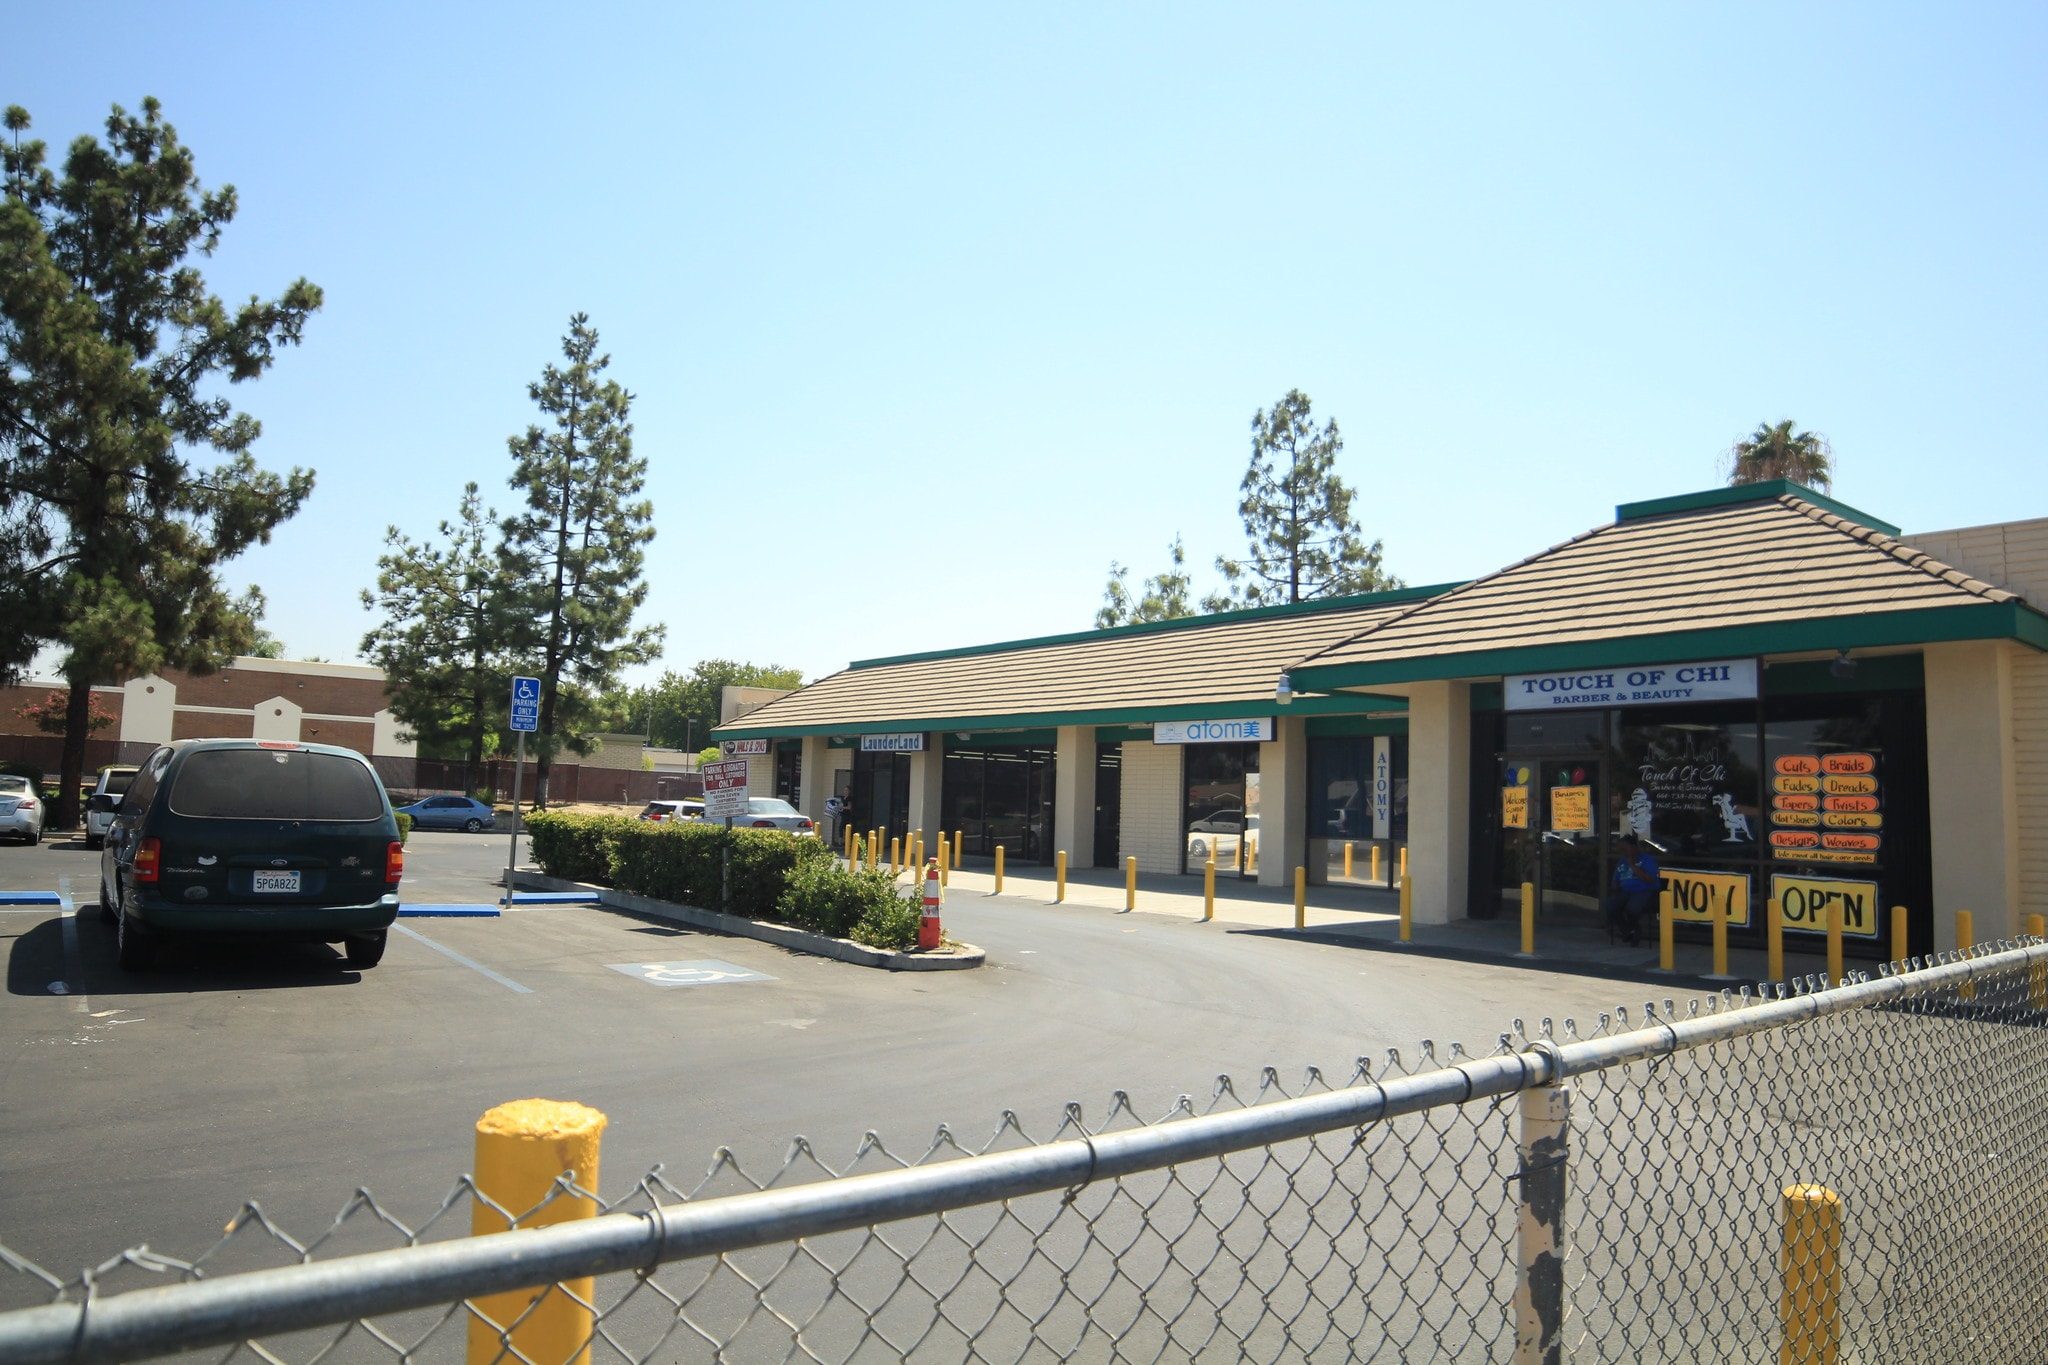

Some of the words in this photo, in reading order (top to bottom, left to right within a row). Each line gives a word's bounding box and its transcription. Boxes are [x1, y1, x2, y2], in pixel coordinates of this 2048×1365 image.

[1522, 674, 1614, 693] TOUCH
[1626, 671, 1665, 687] OF
[1675, 666, 1731, 684] CHI
[1553, 693, 1611, 704] BARBER
[1616, 692, 1627, 701] &
[1632, 688, 1693, 700] BEAUTY
[514, 698, 537, 707] PARKING
[517, 707, 533, 716] ONLY
[736, 741, 749, 753] NAILS
[705, 764, 723, 774] PARKING
[1783, 760, 1811, 773] Cuts
[1829, 760, 1865, 771] Braids
[705, 774, 714, 782] FOR
[1638, 764, 1678, 781] Touch
[1680, 765, 1699, 781] Of
[1700, 764, 1726, 781] Chi
[718, 778, 734, 788] ONLY
[1376, 751, 1387, 820] ATOMY
[1783, 779, 1813, 791] Fades
[1830, 780, 1869, 792] Dreads
[1781, 797, 1813, 810] Tapers
[1831, 798, 1868, 811] Twists
[1775, 814, 1788, 823] Hot
[1828, 815, 1868, 827] Colors
[1776, 835, 1816, 847] Designs
[1826, 837, 1867, 848] Weaves
[1778, 850, 1790, 858] We
[256, 878, 297, 890] 5PGA822
[1782, 886, 1863, 928] OPN
